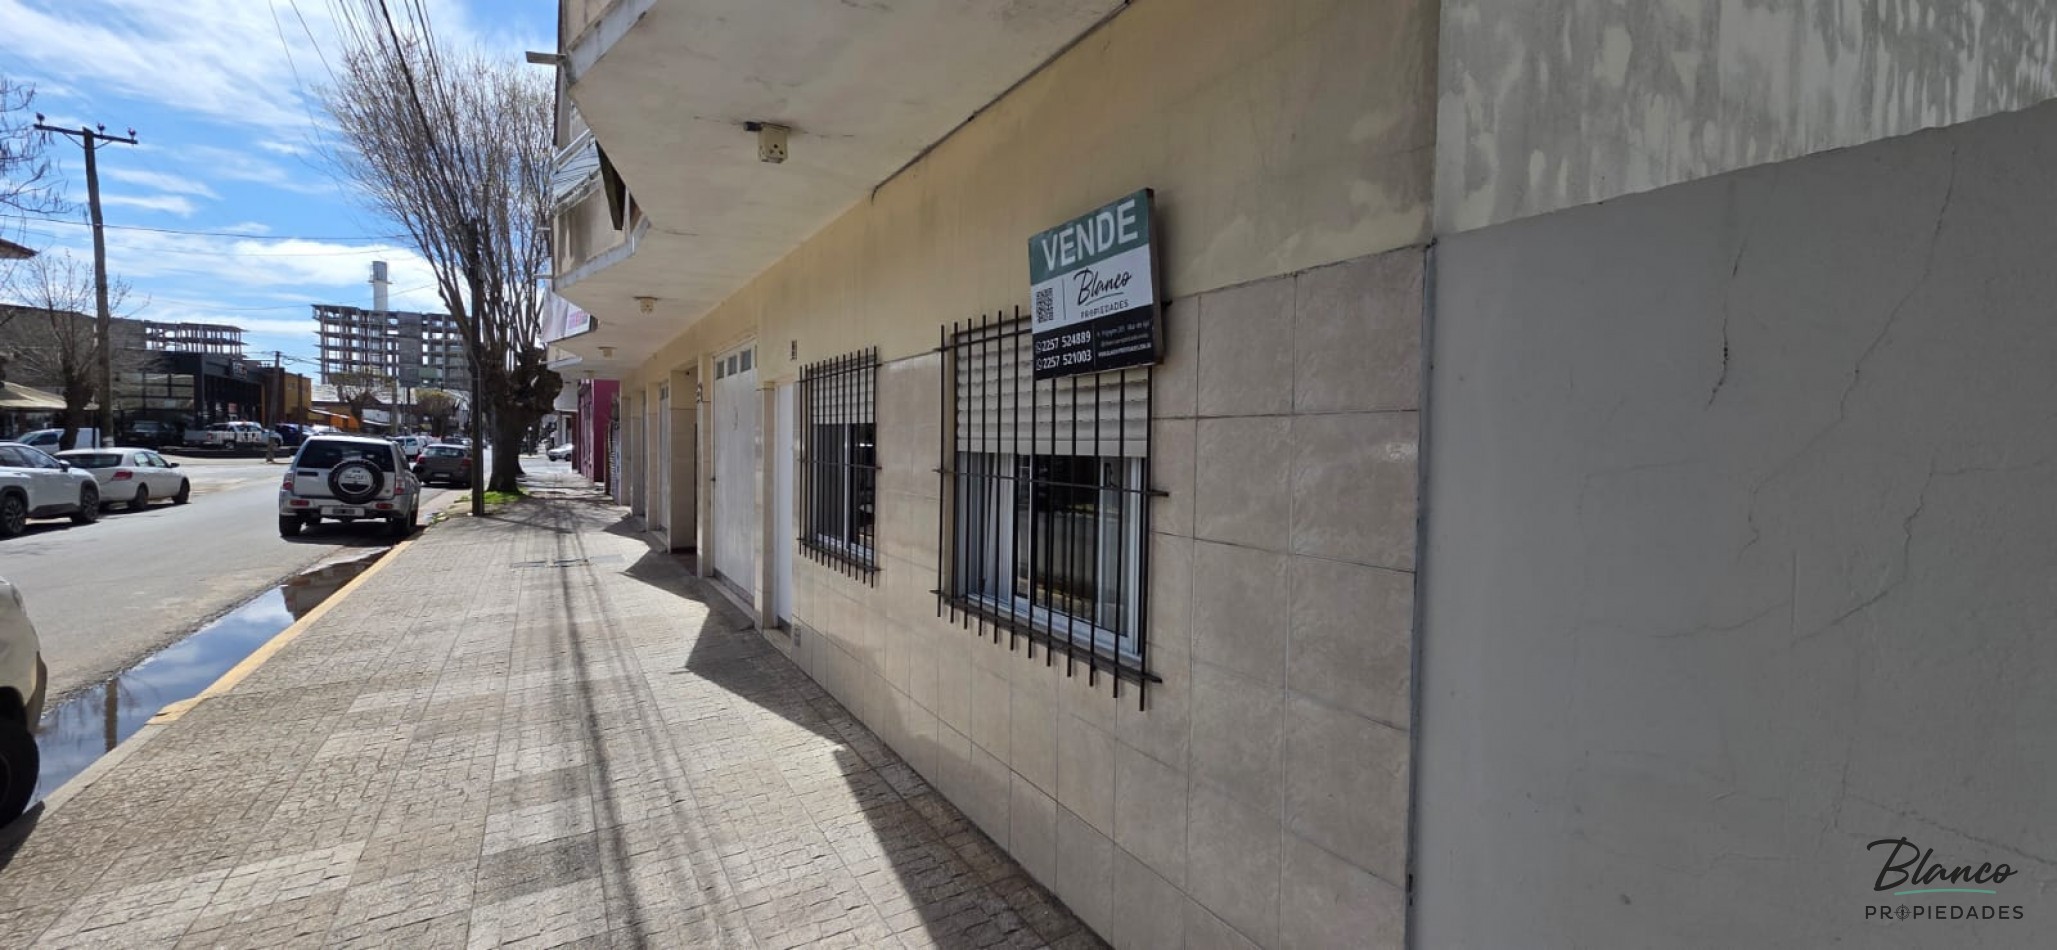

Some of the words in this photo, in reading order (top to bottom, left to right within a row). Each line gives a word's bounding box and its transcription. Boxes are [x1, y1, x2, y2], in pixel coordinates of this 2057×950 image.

[1041, 199, 1139, 272] VENDE
[1073, 267, 1133, 306] Blanco
[1080, 299, 1129, 319] PROPIEDADES
[1042, 337, 1059, 352] 2257
[1061, 330, 1091, 348] 524889
[1042, 355, 1060, 369] 2257
[1062, 349, 1092, 366] 521003
